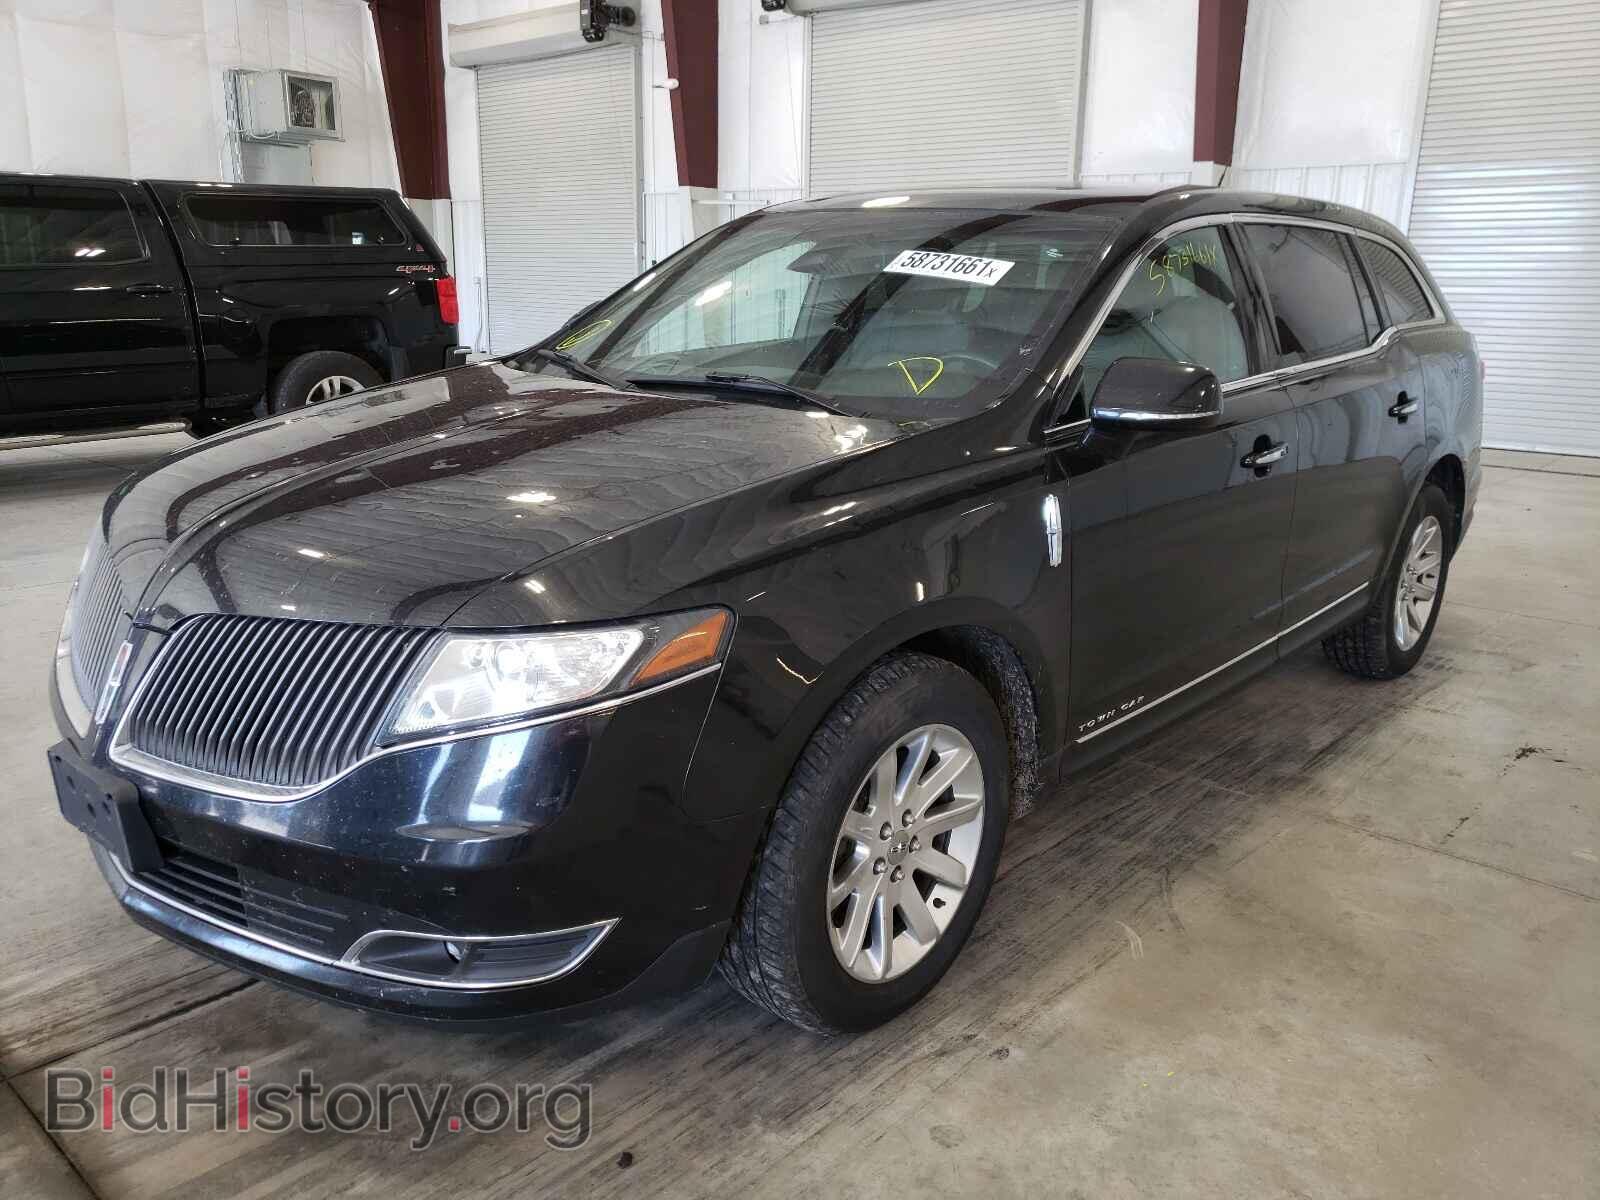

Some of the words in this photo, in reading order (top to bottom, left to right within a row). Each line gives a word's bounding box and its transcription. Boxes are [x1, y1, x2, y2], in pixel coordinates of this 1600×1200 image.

[887, 356, 944, 395] D
[1078, 709, 1117, 732] TOWN
[1120, 695, 1145, 711] CAR
